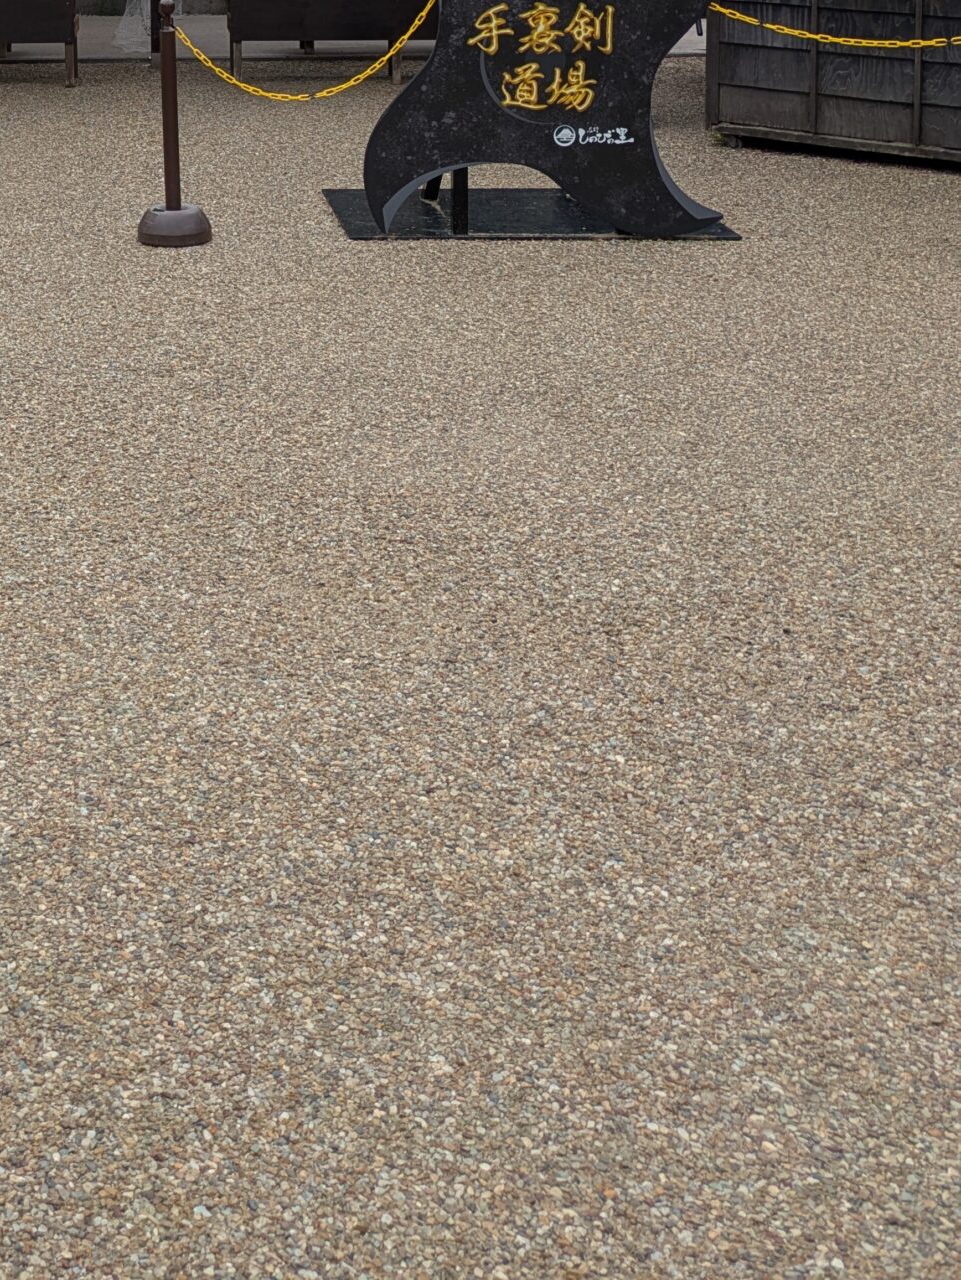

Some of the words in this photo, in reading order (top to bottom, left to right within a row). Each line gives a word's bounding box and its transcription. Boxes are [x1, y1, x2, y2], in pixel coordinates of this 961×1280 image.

[467, 2, 616, 55] 手裏剣
[501, 60, 598, 112] 道場
